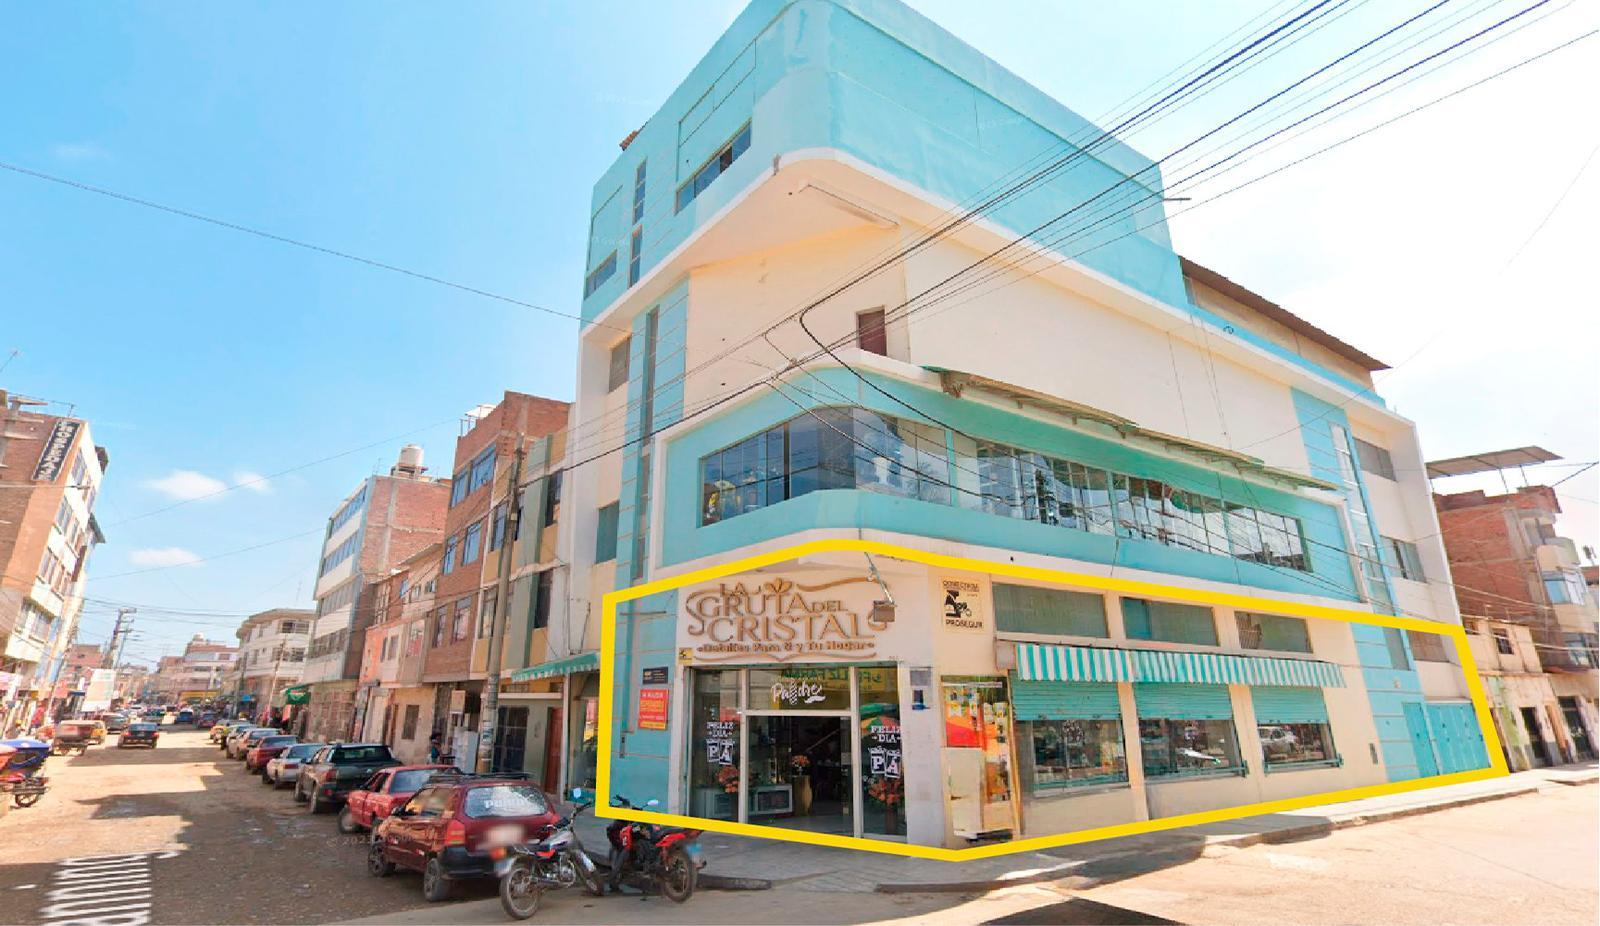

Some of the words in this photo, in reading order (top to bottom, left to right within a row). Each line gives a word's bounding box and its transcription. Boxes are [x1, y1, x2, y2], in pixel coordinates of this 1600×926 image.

[719, 582, 748, 596] LA
[696, 592, 814, 618] GRUTA
[811, 600, 849, 613] DEL
[707, 612, 876, 643] CRISTAL
[946, 619, 983, 628] PROSEGUR
[706, 721, 734, 729] FELIZ
